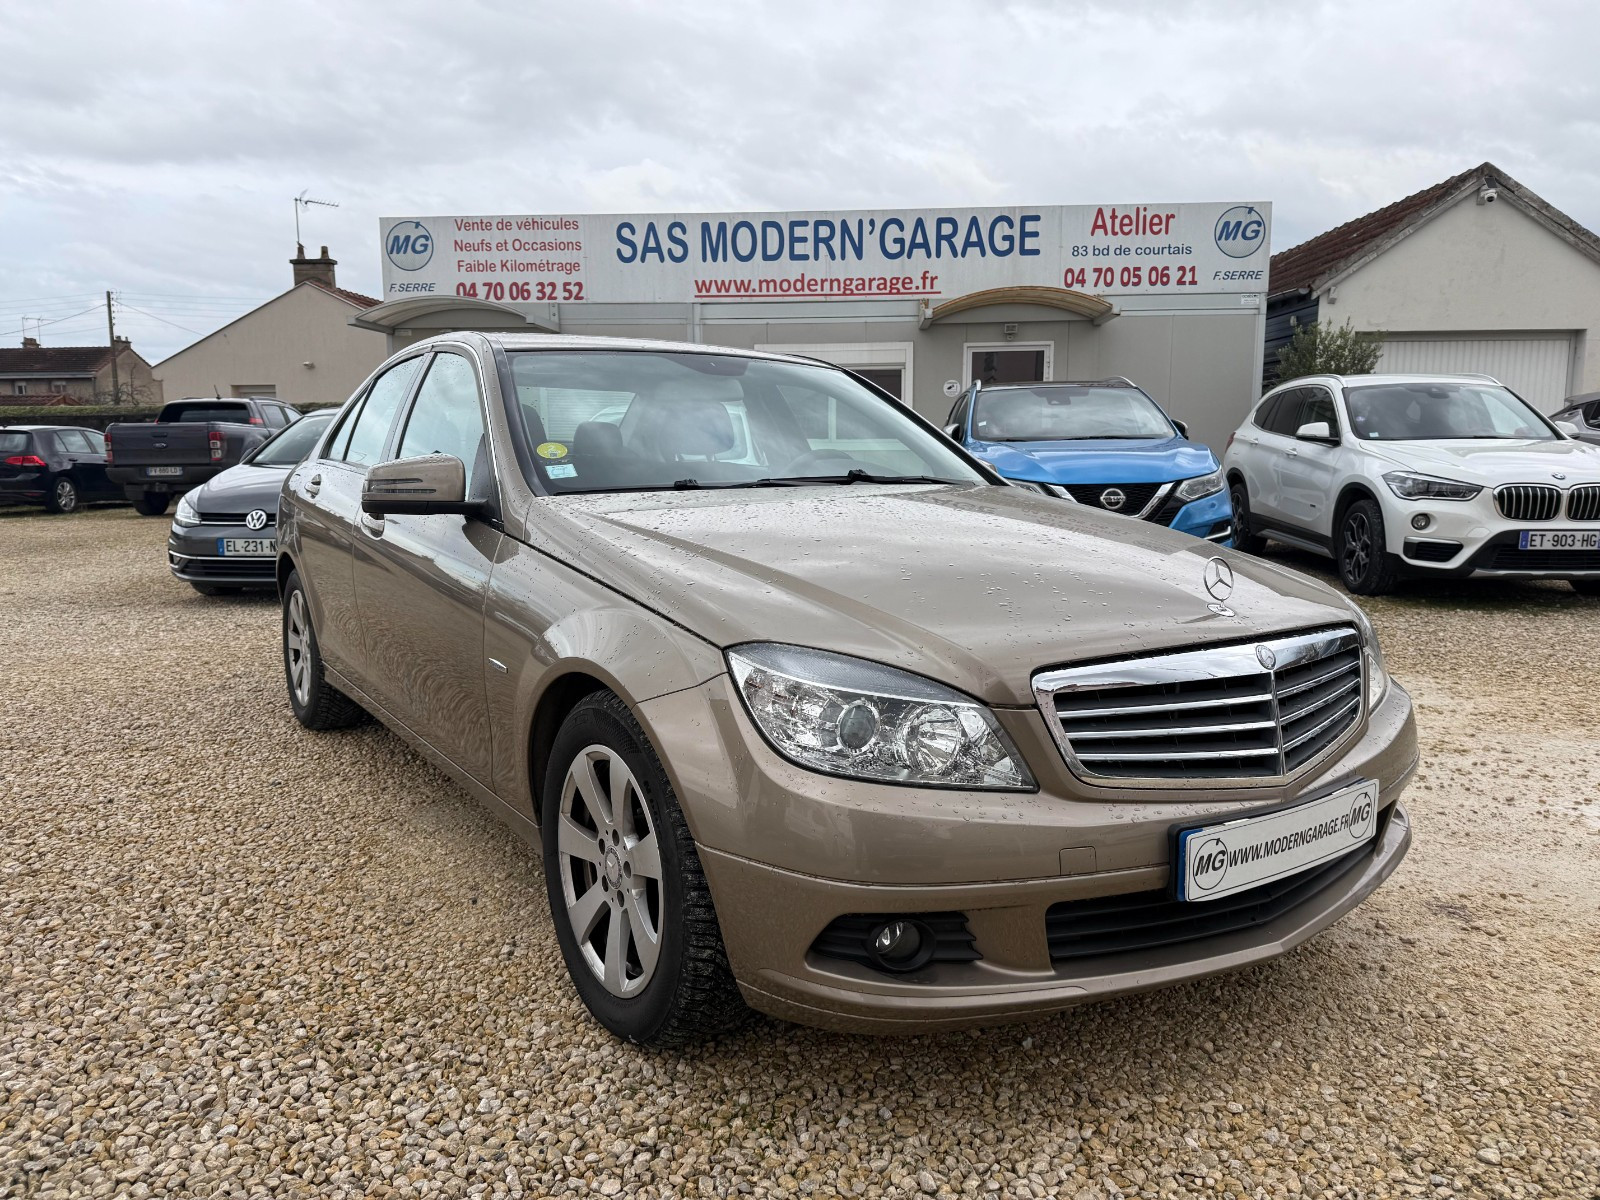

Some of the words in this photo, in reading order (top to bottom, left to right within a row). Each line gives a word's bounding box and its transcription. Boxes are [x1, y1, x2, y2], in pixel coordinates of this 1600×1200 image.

[454, 218, 492, 231] Vente
[496, 218, 512, 230] de
[516, 217, 579, 230] véhicules
[1090, 206, 1175, 236] Atelier
[1217, 220, 1262, 241] MG
[389, 234, 430, 255] MG
[454, 239, 492, 252] Neufs
[496, 239, 509, 251] et
[512, 238, 582, 251] Occasions
[616, 221, 689, 263] SAS
[1072, 245, 1088, 256] 83
[1092, 245, 1110, 256] bd
[1114, 244, 1131, 255] de
[1135, 243, 1192, 255] courtais
[457, 259, 497, 272] Faible
[500, 259, 581, 275] Kilométrage
[1064, 267, 1086, 288] 04
[1092, 267, 1114, 288] 70
[1120, 266, 1142, 287] 05
[1148, 266, 1170, 286] 06
[1176, 265, 1198, 286] 21
[1213, 270, 1264, 281] F.SERRE
[389, 282, 436, 293] F.SERRE
[456, 282, 478, 298] 04
[482, 282, 504, 301] 70
[509, 281, 531, 300] 06
[536, 281, 557, 300] 32
[562, 281, 584, 300] 52
[694, 270, 941, 298] www.moderngarage.fr
[1529, 533, 1598, 548] ET-903-HG
[1350, 802, 1371, 827] MG
[1229, 813, 1349, 868] WWW.MODERNGARAGE.FR
[1195, 849, 1227, 877] MG
